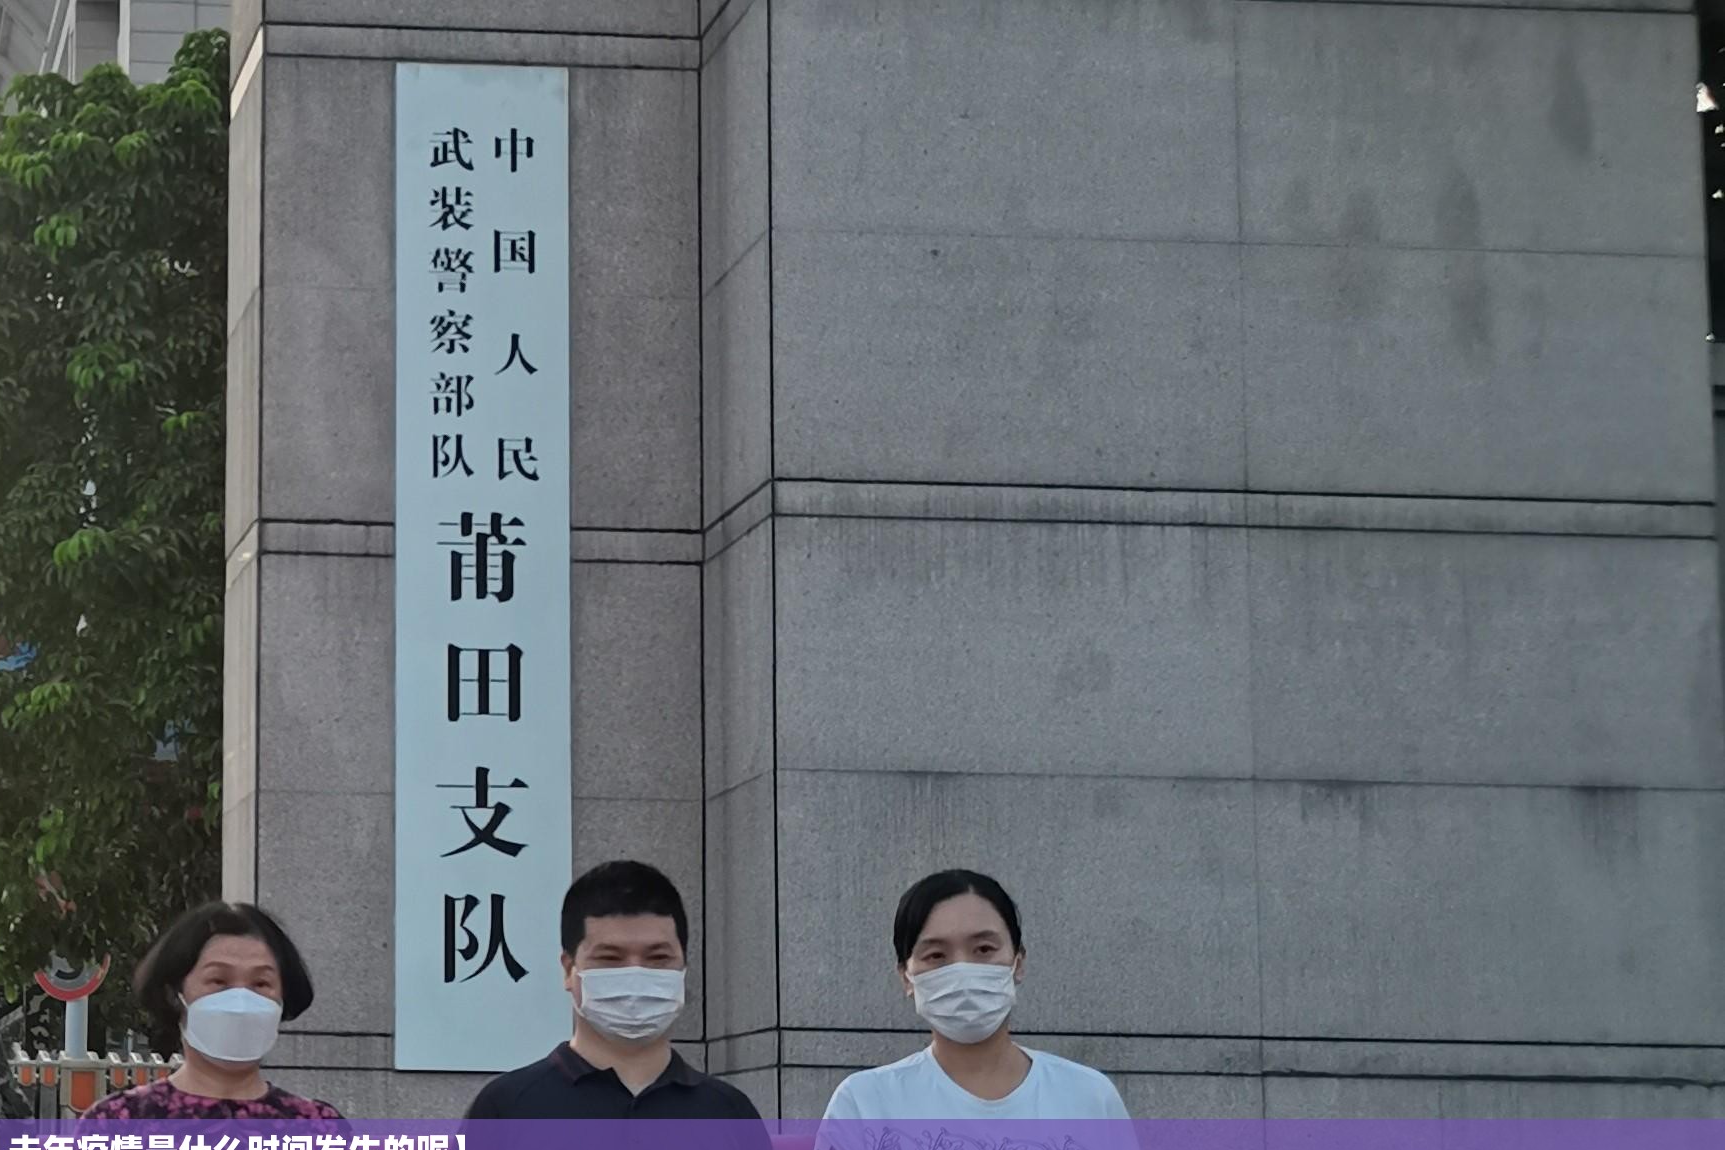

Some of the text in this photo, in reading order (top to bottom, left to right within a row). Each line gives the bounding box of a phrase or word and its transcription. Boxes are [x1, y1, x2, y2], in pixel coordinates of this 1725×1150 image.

[429, 126, 475, 479] 武装警察部队
[493, 127, 540, 481] 中国人民
[435, 511, 530, 984] 莆田支队
